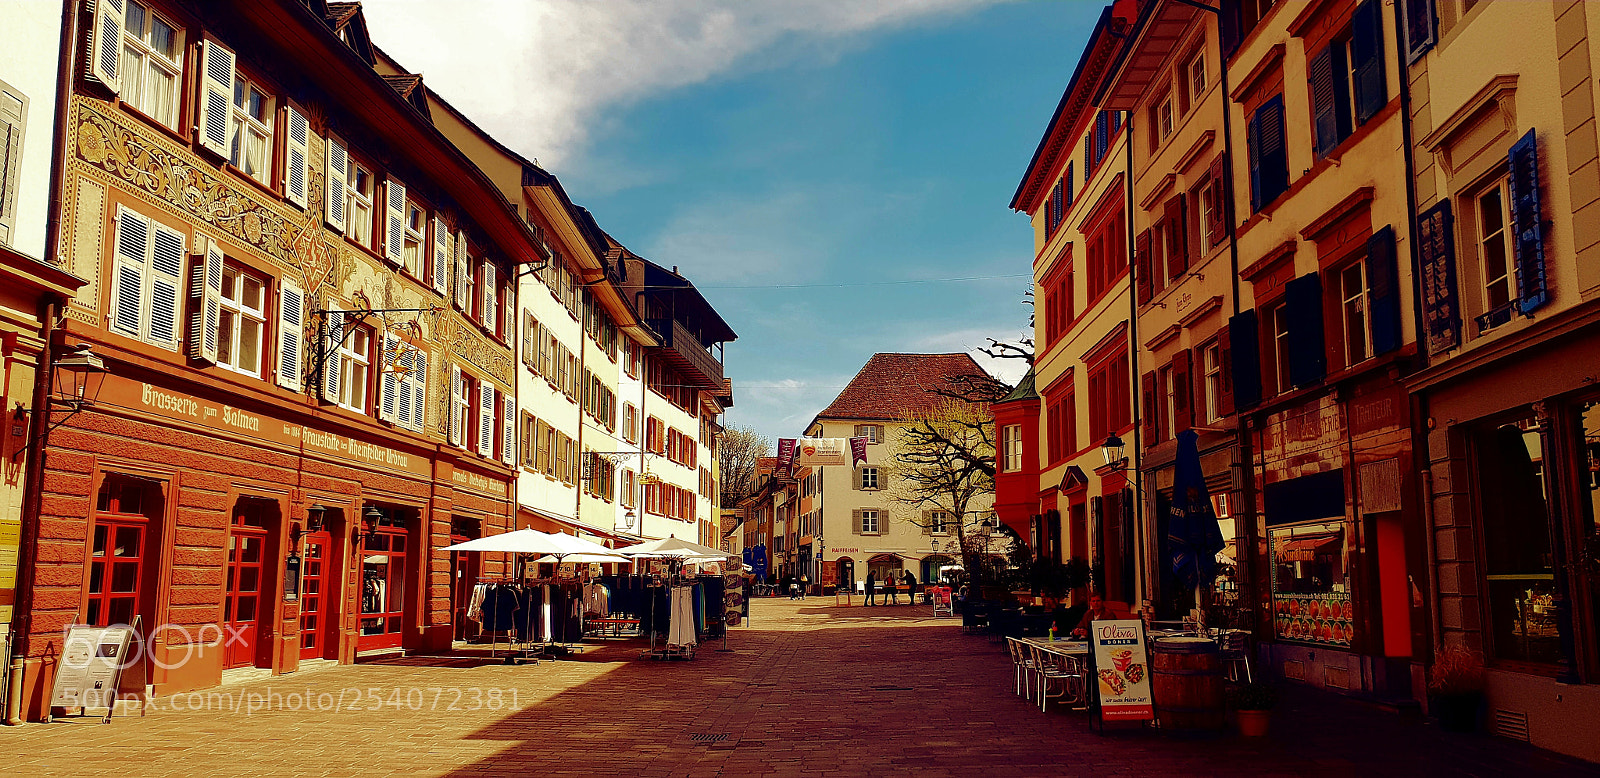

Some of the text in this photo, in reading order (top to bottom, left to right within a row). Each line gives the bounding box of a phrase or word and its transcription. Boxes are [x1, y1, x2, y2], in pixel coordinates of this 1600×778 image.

[141, 382, 259, 432] Brasserie zum Salmen
[1284, 547, 1315, 562] Sunshine
[1103, 624, 1135, 639] Oliva
